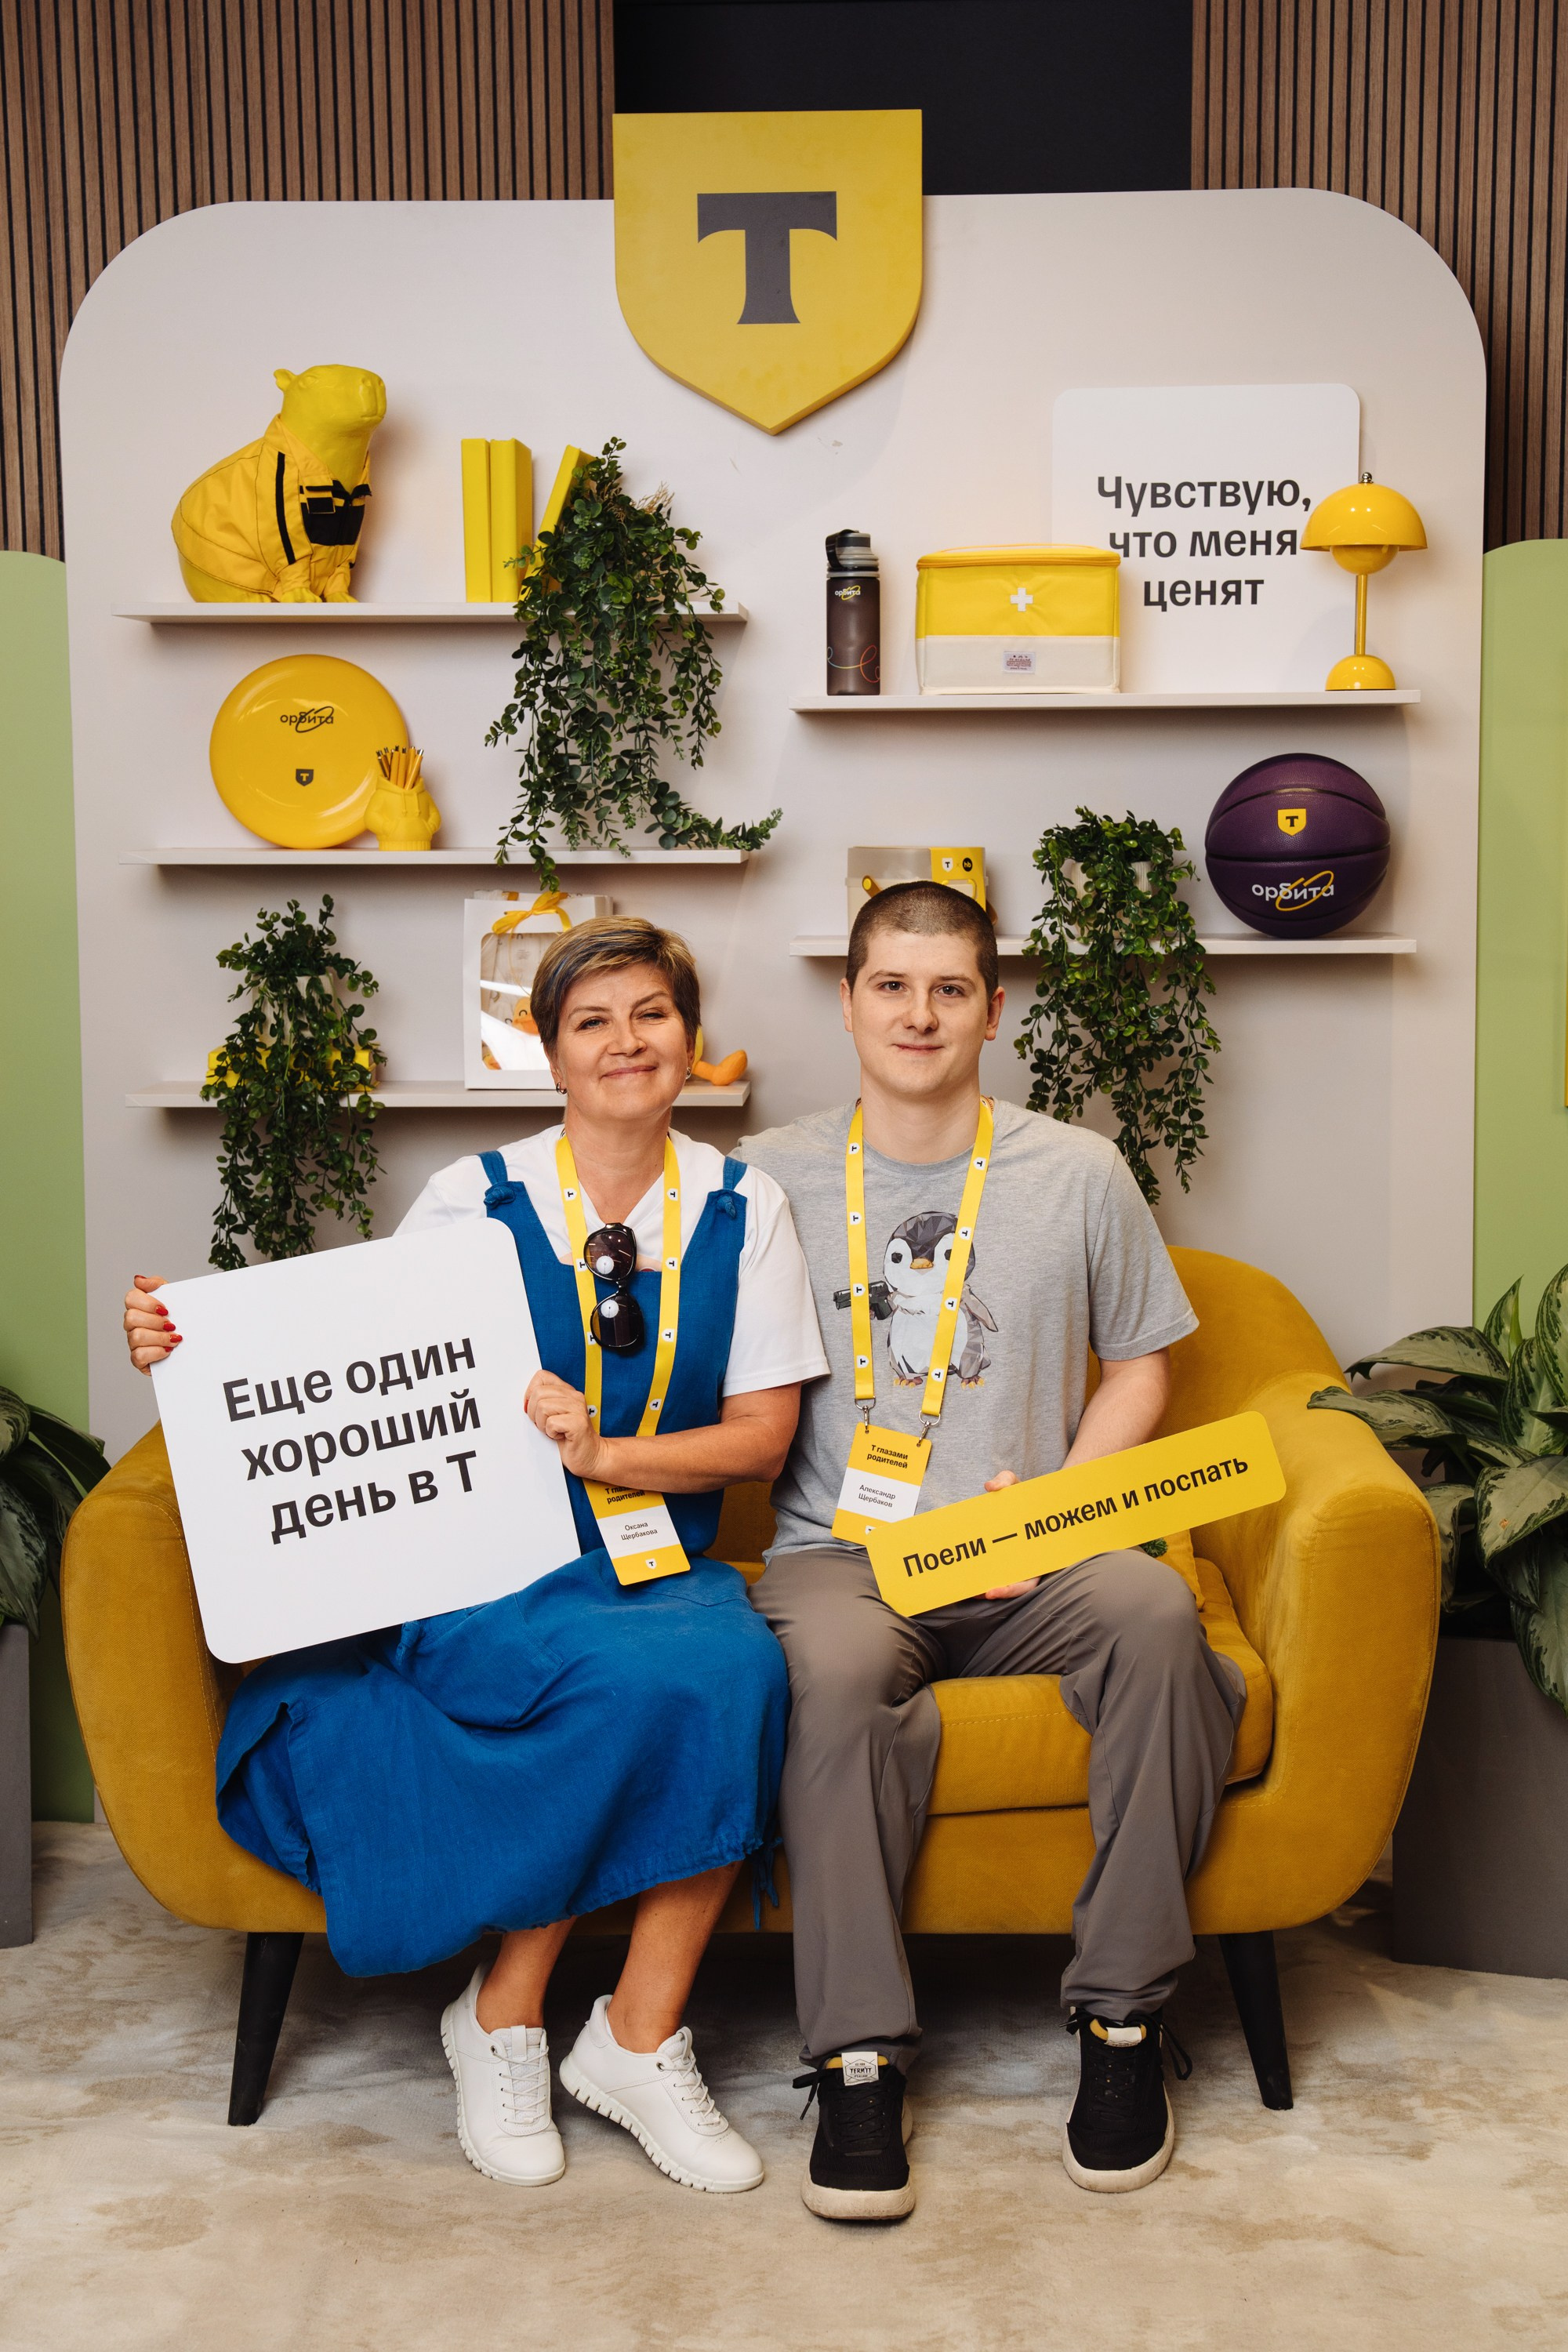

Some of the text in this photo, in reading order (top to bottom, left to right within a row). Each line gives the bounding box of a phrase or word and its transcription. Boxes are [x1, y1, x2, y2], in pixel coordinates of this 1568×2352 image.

[1098, 476, 1311, 517] Чувствую,
[1109, 530, 1298, 557] что меня
[1144, 579, 1265, 612] ценят
[223, 1338, 476, 1422] Еще один
[241, 1388, 481, 1481] хороший
[866, 1454, 908, 1469] родителей
[877, 1446, 908, 1460] глазами
[607, 1490, 645, 1504] родителей
[858, 1493, 893, 1508] Щербаков
[859, 1484, 896, 1500] Александр
[270, 1482, 396, 1545] день
[408, 1470, 438, 1504] в
[902, 1537, 987, 1577] Поели
[1024, 1497, 1118, 1541] можем
[1122, 1490, 1140, 1509] и
[1143, 1457, 1248, 1502] поспать
[620, 1528, 658, 1541] Щербакова
[624, 1522, 648, 1531] Оксана
